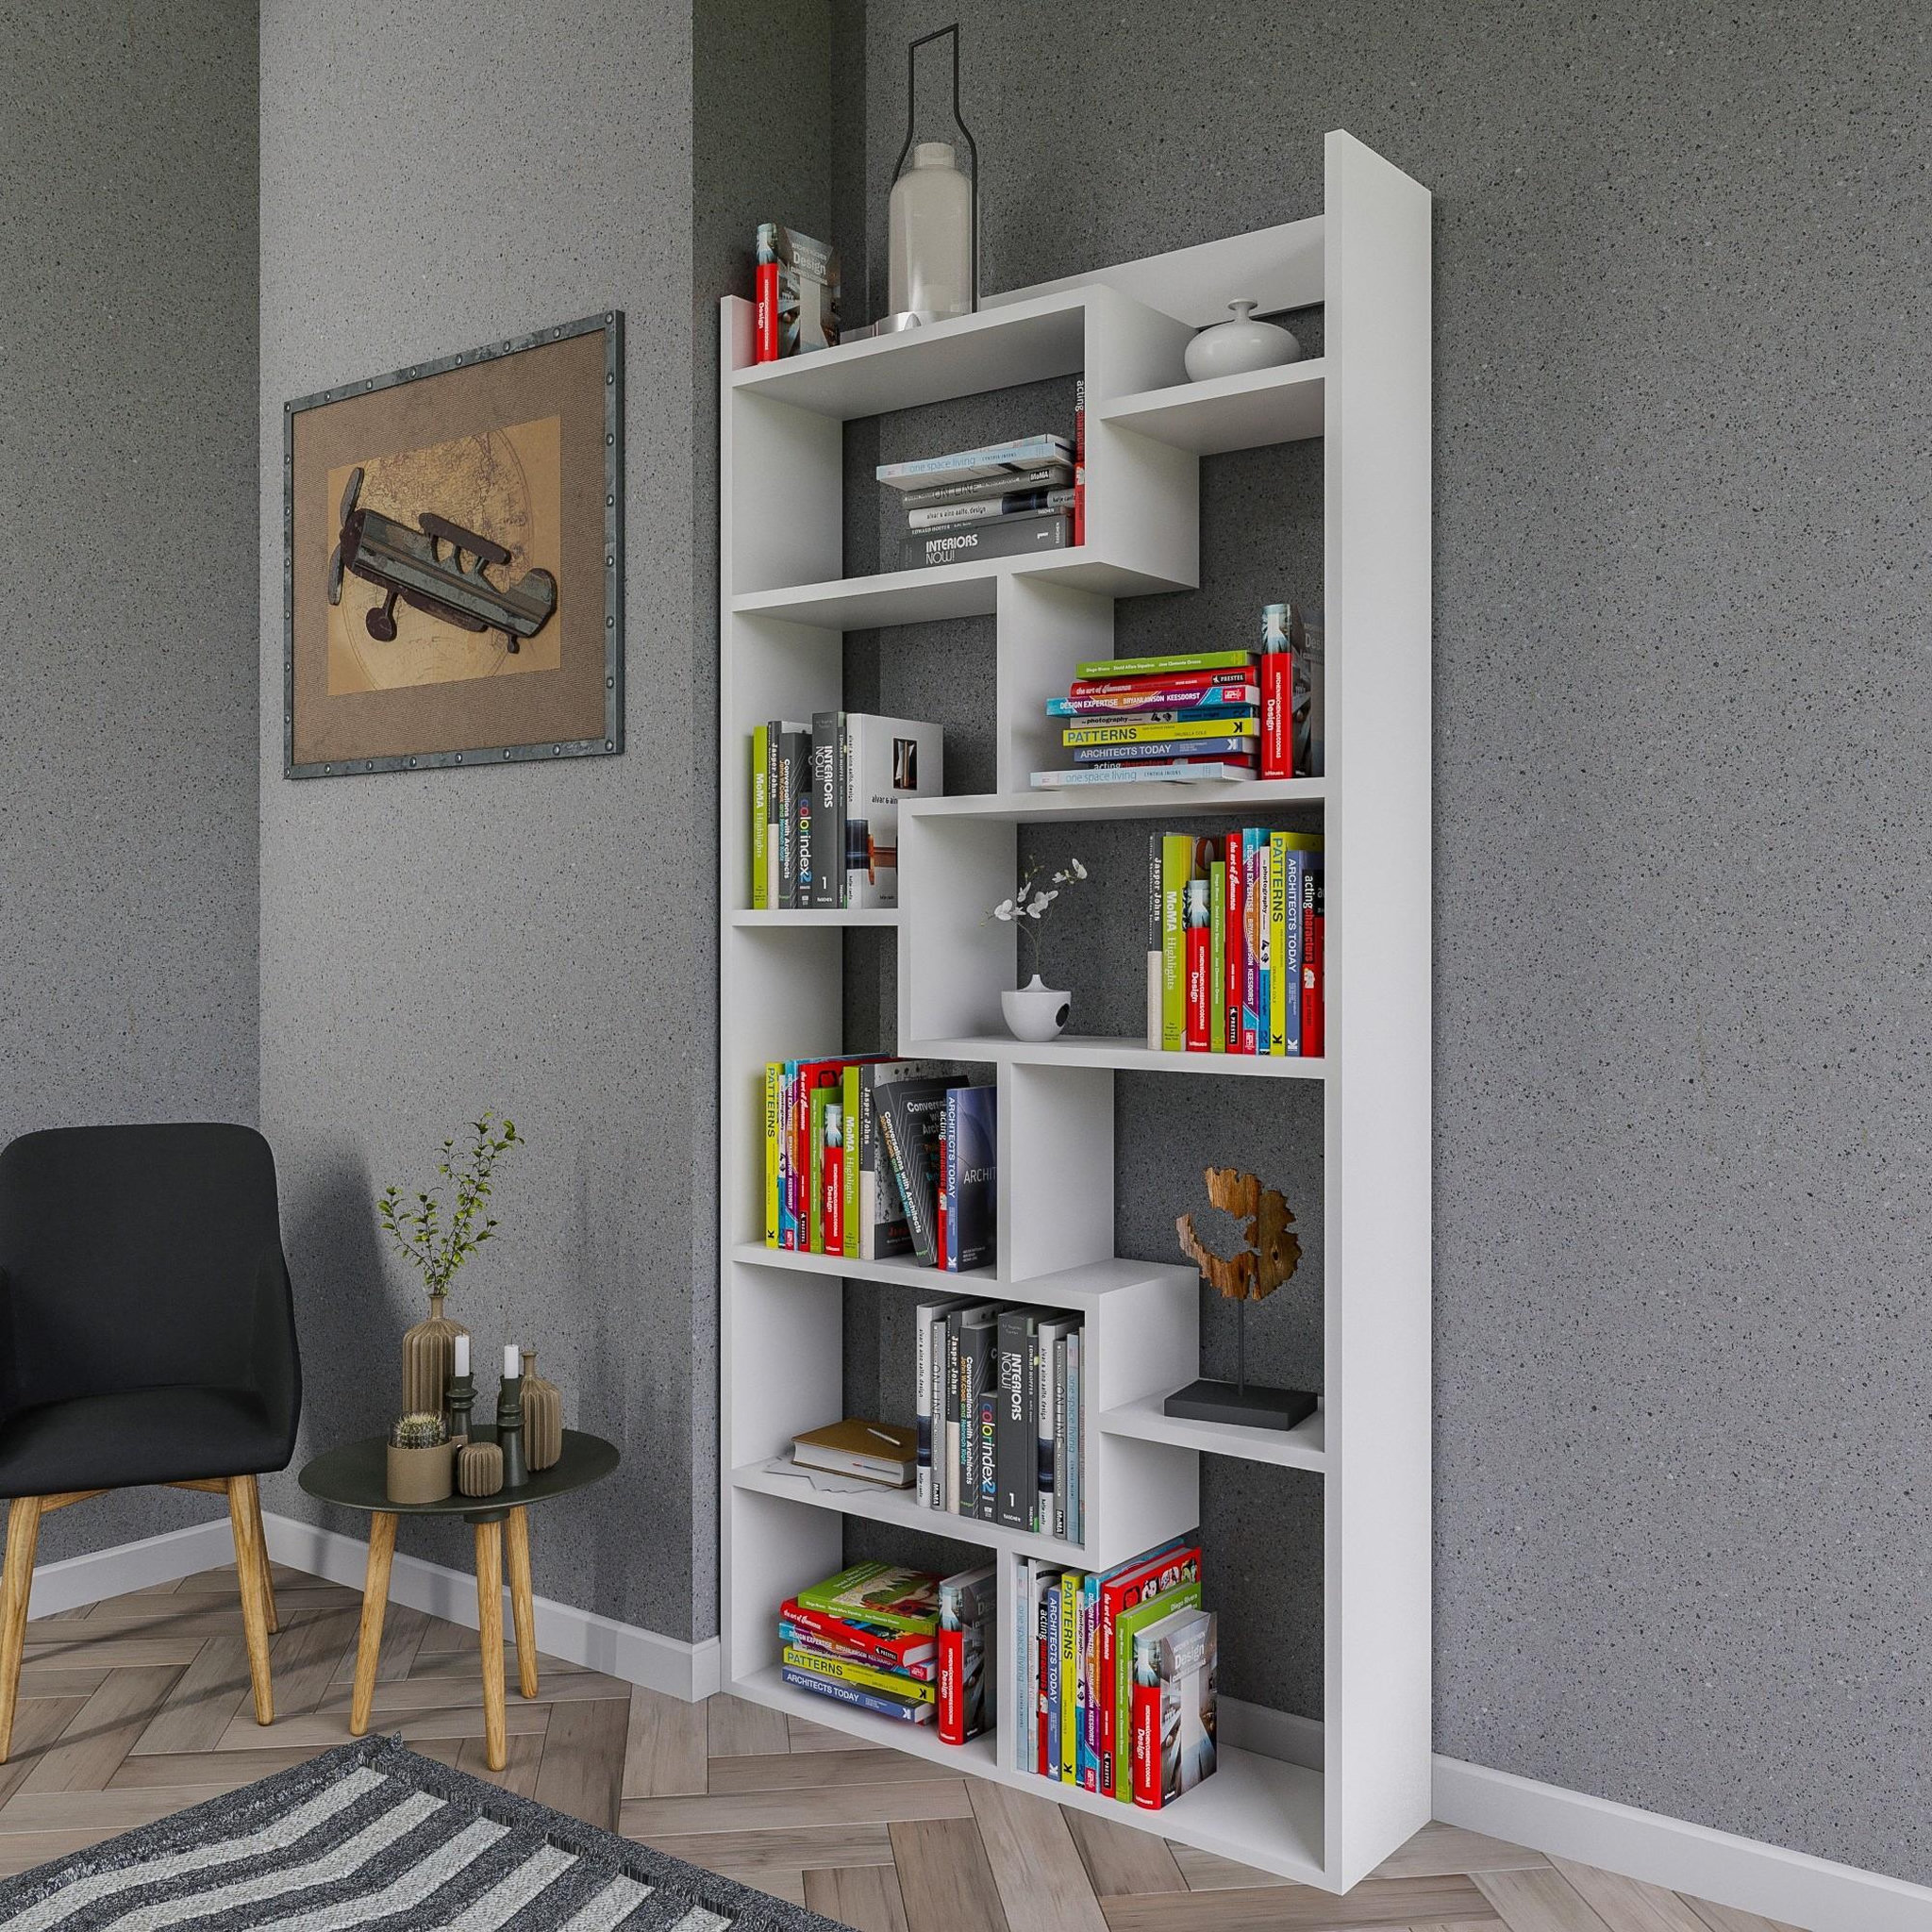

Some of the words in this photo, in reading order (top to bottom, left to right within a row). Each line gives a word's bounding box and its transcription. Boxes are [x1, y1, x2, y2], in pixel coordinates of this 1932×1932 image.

[793, 251, 826, 275] Design
[927, 459, 951, 472] space
[953, 457, 975, 468] living
[1030, 471, 1049, 481] MoMA
[970, 506, 987, 515] design
[926, 534, 978, 553] INTERIORS
[926, 551, 955, 565] NOW!
[1059, 700, 1082, 709] DESIGN
[1084, 698, 1118, 708] EXPERTISE
[1094, 685, 1101, 694] of
[1087, 716, 1128, 725] photography
[1266, 699, 1275, 732] Design
[1067, 727, 1137, 743] PATTERNS
[1081, 746, 1137, 758] ARCHITECTS
[1140, 744, 1172, 755] TODAY
[756, 773, 764, 808] MoMA
[824, 745, 833, 808] INTERIORS
[1066, 774, 1083, 783] one
[1084, 773, 1110, 784] space
[1113, 770, 1137, 781] living
[872, 795, 884, 805] alvar
[890, 796, 898, 805] ain
[756, 812, 764, 858] Highlights
[799, 798, 812, 882] colorindex2
[1229, 841, 1238, 853] the
[822, 876, 827, 890] 1
[1153, 857, 1161, 891] Jasper
[1229, 866, 1238, 875] of
[1273, 838, 1283, 923] PATTERNS
[1288, 858, 1297, 931] ARCHITECTS
[1166, 891, 1177, 932] MoMA
[1165, 937, 1176, 990] Highlights
[1288, 932, 1297, 973] TODAY
[1191, 972, 1199, 1003] Design
[767, 1067, 775, 1138] PATTERNS
[846, 1116, 855, 1153] MoMA
[845, 1157, 855, 1205] Highlights
[885, 1111, 904, 1171] Conversations
[900, 1171, 910, 1190] with
[906, 1191, 922, 1234] Architects
[963, 1167, 996, 1185] ARCHIT
[951, 1336, 959, 1366] Jasper
[1001, 1351, 1012, 1390] NOW!
[1011, 1353, 1022, 1421] INTERIORS
[982, 1403, 996, 1493] colorindex2
[1068, 1425, 1076, 1454] living
[1008, 1492, 1015, 1507] 1
[1104, 1593, 1112, 1604] the
[1049, 1597, 1058, 1664] ARCHITECTS
[1063, 1580, 1074, 1660] PATTERNS
[1104, 1617, 1111, 1627] of
[788, 1652, 843, 1675] PATTERNS
[1017, 1656, 1026, 1682] living
[1174, 1644, 1205, 1670] Design
[787, 1674, 832, 1694] ARCHITECTS
[833, 1687, 859, 1702] TODAY
[1049, 1666, 1058, 1704] TODAY
[1137, 1728, 1145, 1760] Design
